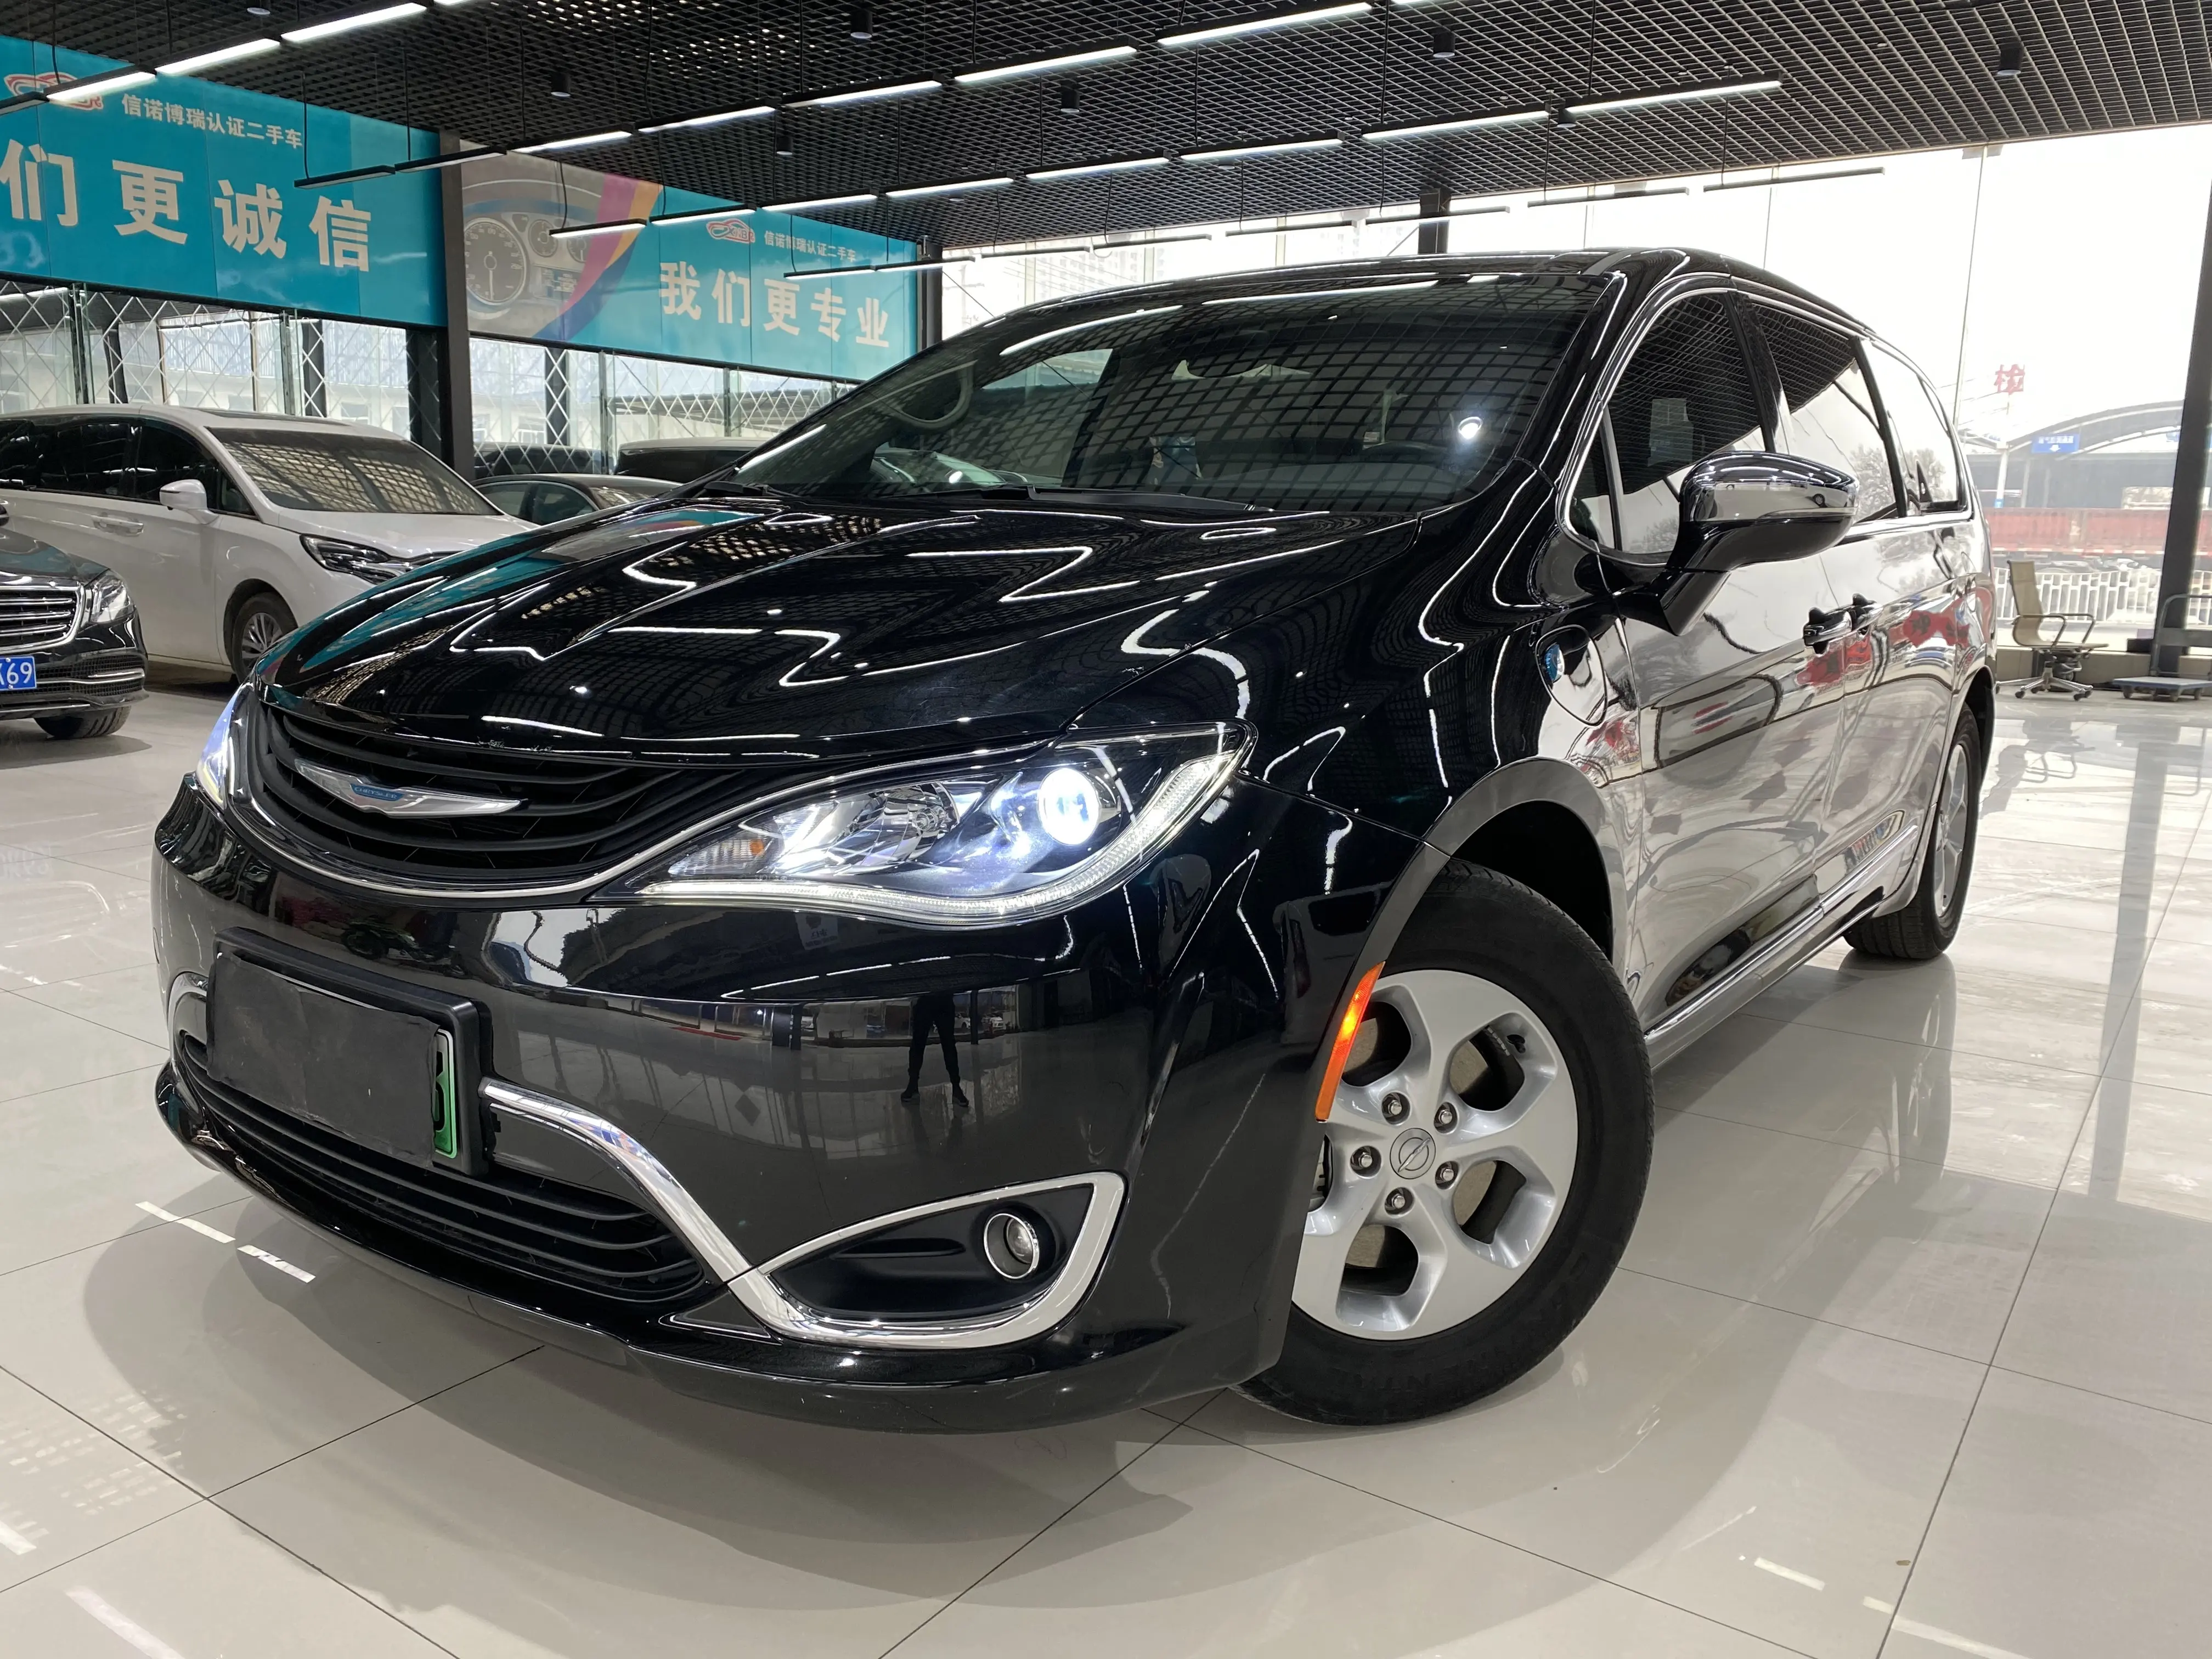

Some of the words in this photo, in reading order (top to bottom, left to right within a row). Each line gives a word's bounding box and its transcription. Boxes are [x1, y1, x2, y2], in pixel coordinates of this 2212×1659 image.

[122, 93, 302, 149] 信诺博瑞认证二手车
[764, 230, 856, 262] 信诺博瑞认证二手车
[659, 261, 889, 348] 我们更专业
[0, 662, 32, 685] 69
[354, 786, 398, 799] CHRYSLER
